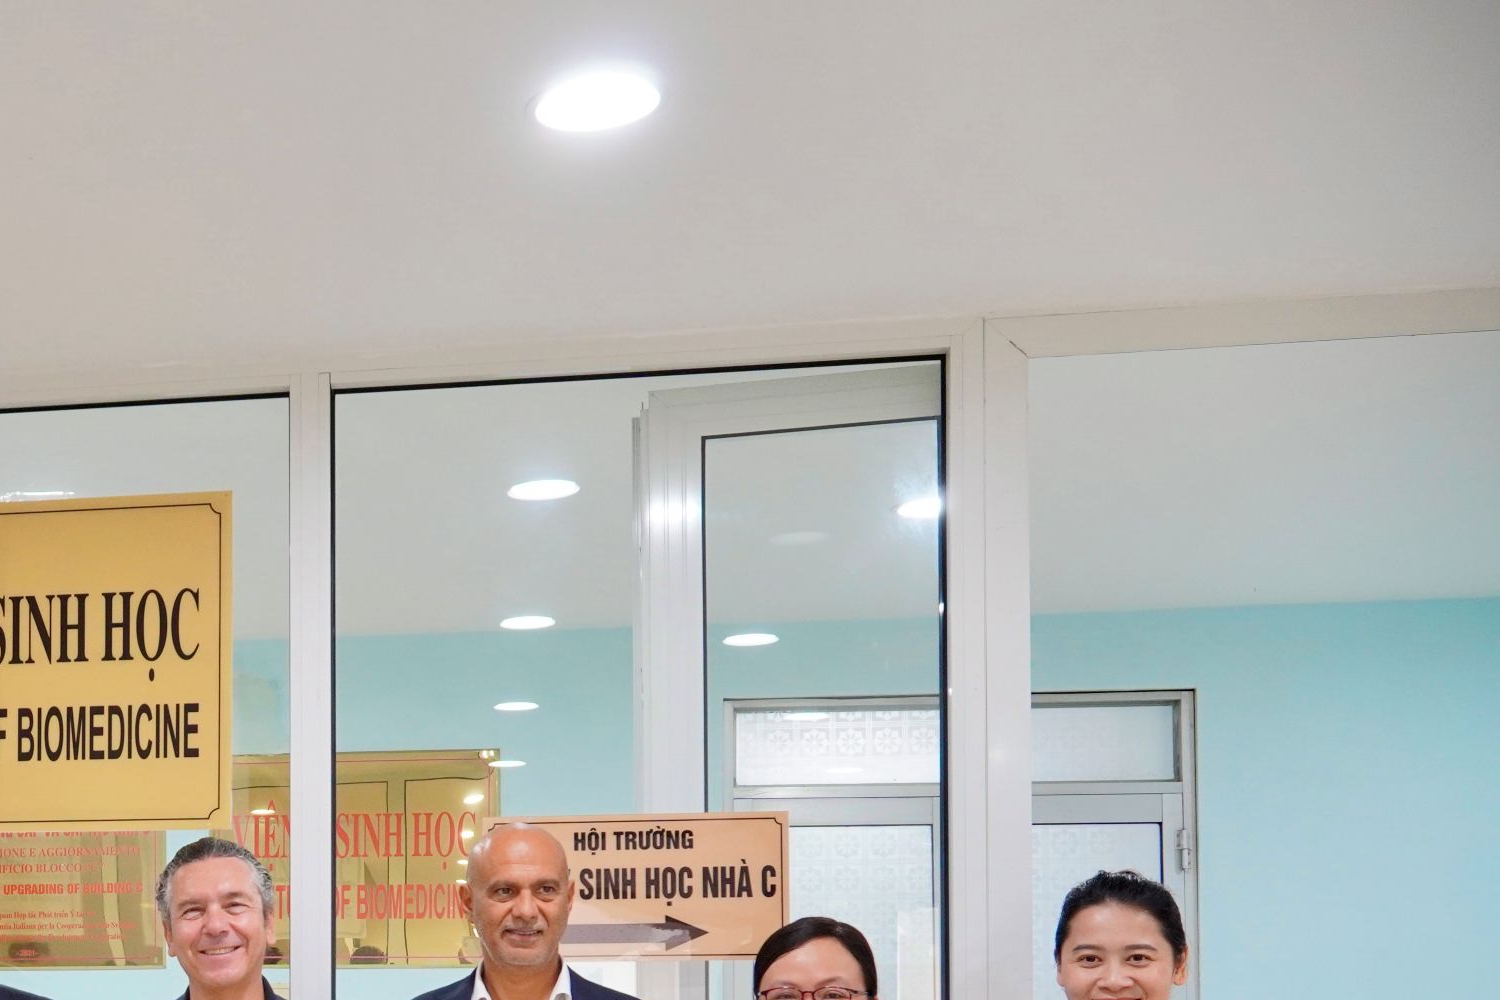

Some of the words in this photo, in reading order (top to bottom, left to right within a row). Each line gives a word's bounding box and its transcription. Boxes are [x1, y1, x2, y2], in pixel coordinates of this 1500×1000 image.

[102, 588, 200, 682] HỌC
[17, 703, 200, 762] BIOMEDICINE
[336, 812, 404, 858] SINH
[574, 828, 606, 855] HỘI
[614, 826, 694, 851] TRƯỜNG
[4, 883, 63, 895] UPGRADING
[68, 884, 79, 894] OF
[357, 883, 468, 919] BIOMEDICIN
[579, 867, 636, 900] SINH
[645, 866, 693, 906] HỌC
[702, 859, 753, 898] NHÀ
[761, 864, 776, 897] C
